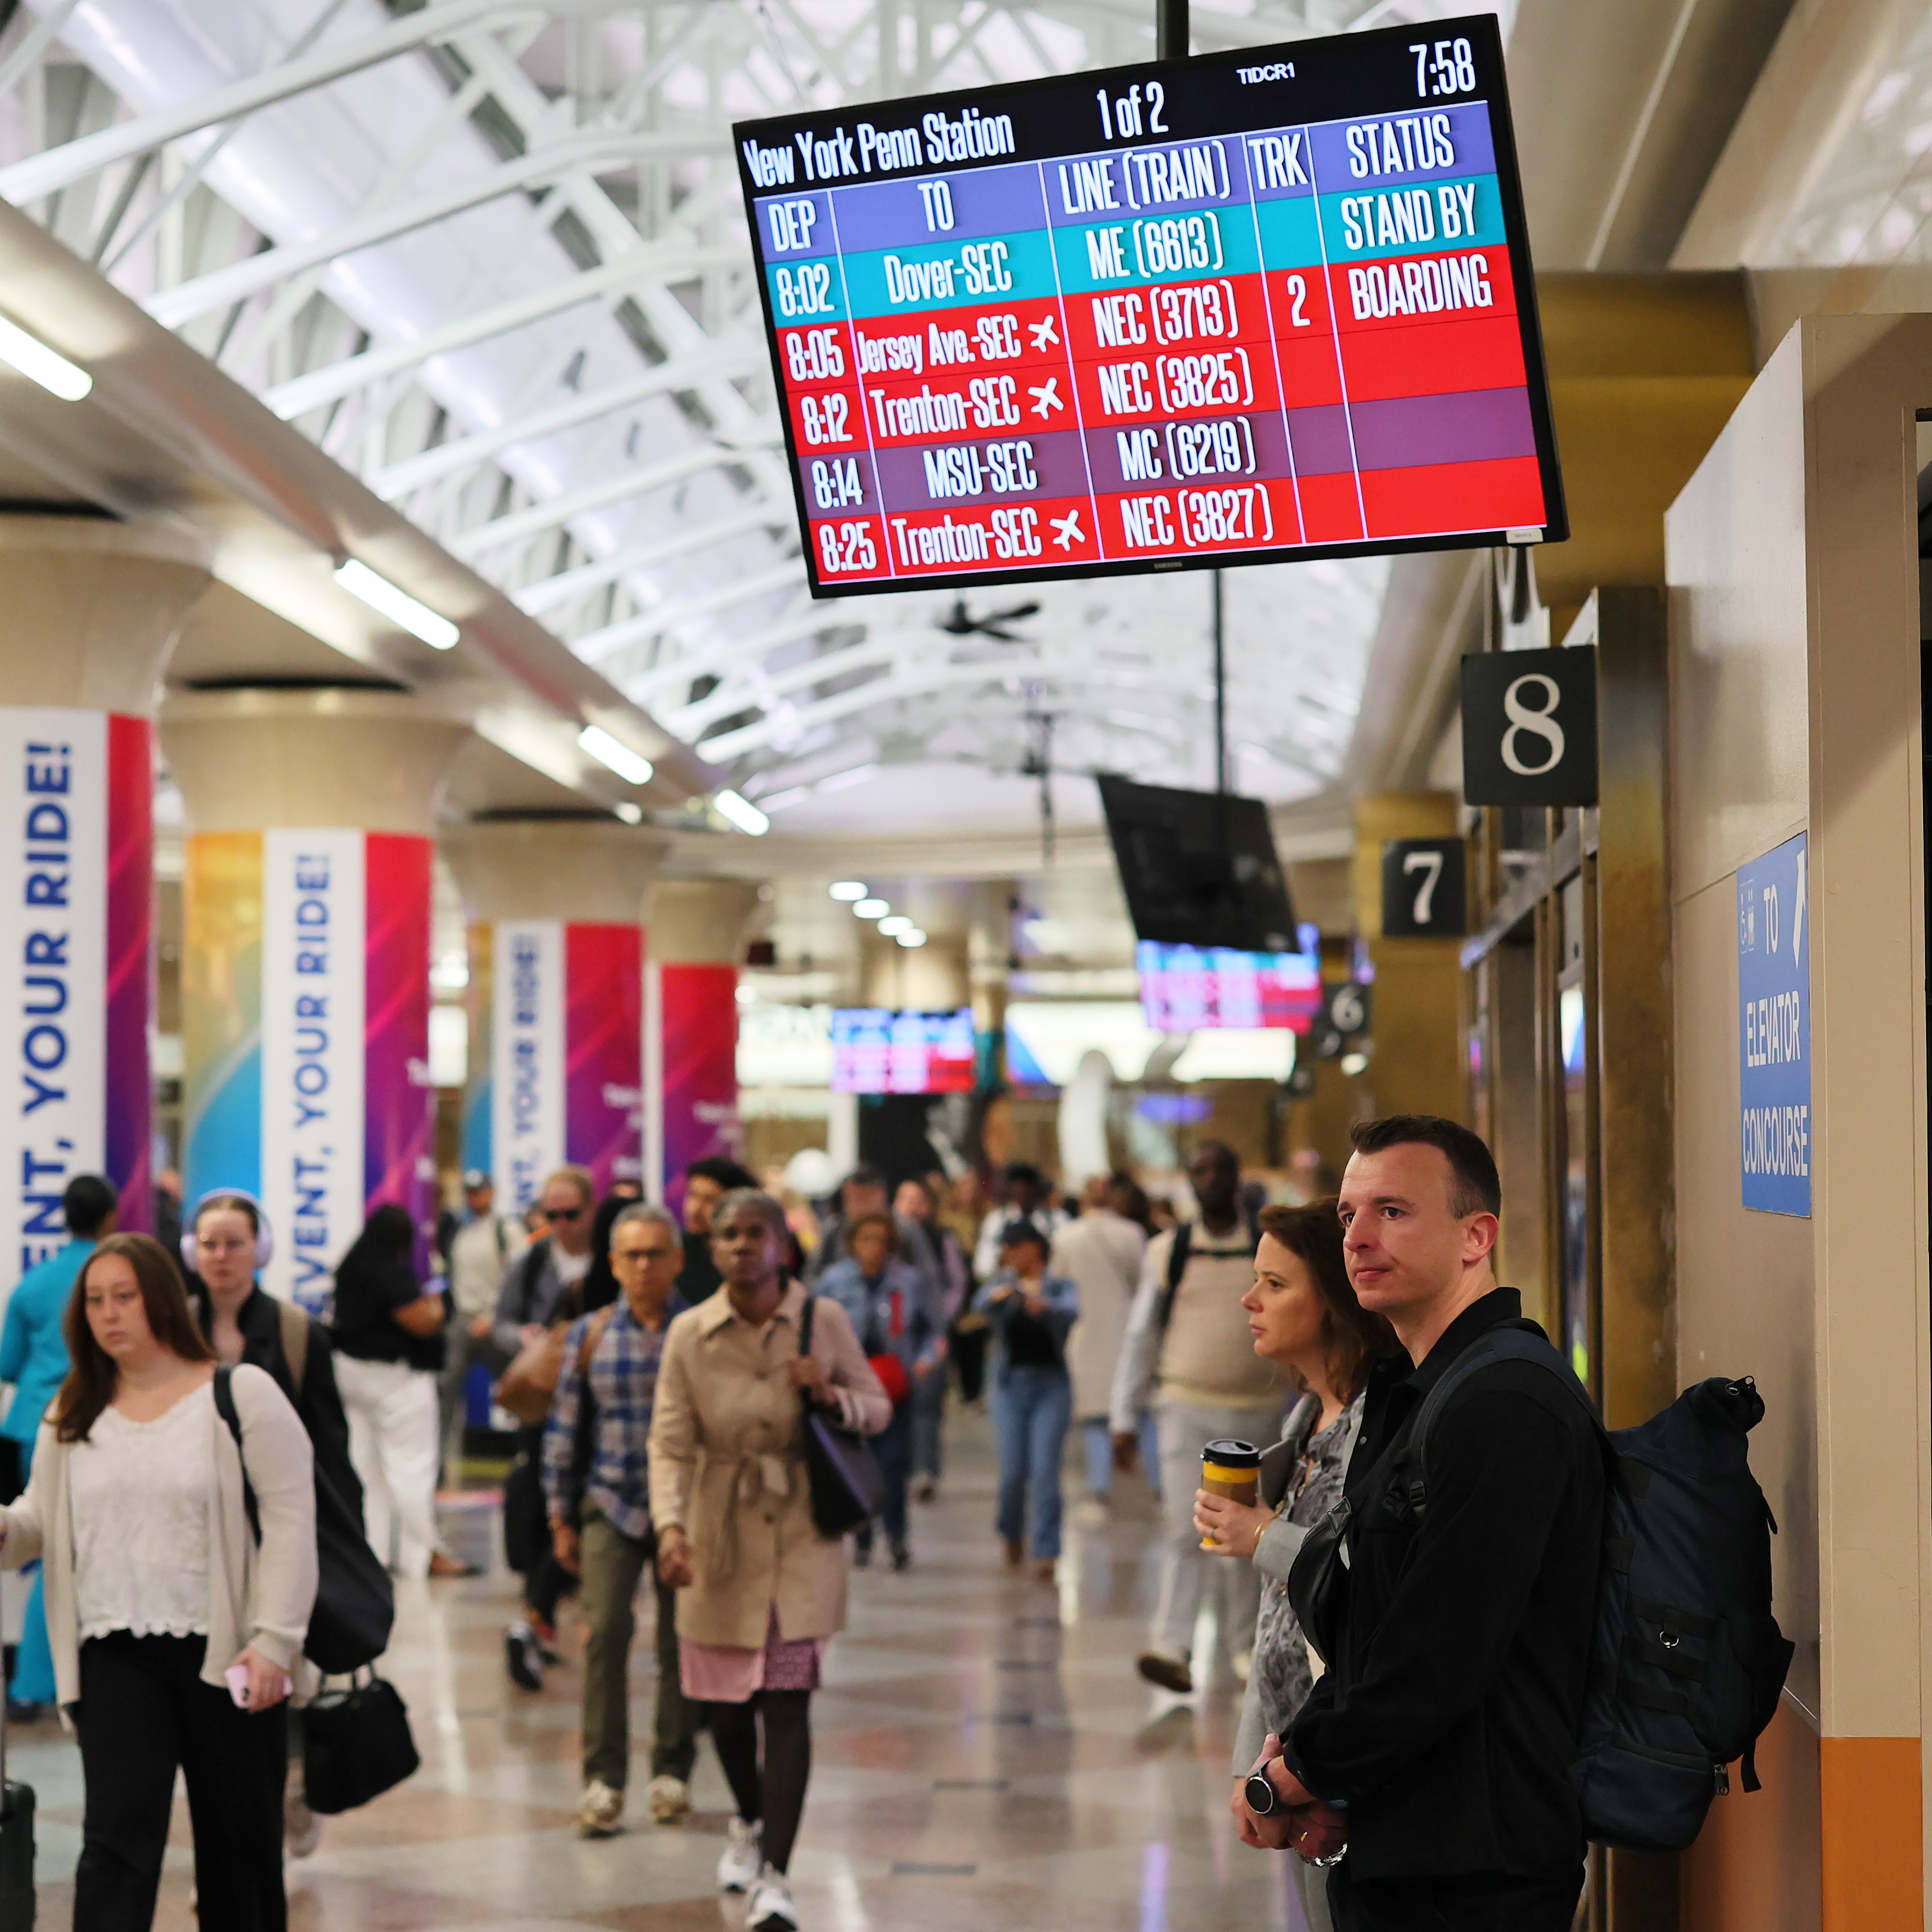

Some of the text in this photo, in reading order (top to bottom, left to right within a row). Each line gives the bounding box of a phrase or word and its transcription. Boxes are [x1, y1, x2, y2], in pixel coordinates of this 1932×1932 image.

[795, 128, 859, 180] York
[858, 124, 923, 172] Penn
[923, 108, 1015, 163] Station
[1097, 89, 1113, 140] 1
[1116, 85, 1143, 138] of
[1146, 82, 1169, 133] 2
[1237, 62, 1295, 84] TIDCR1
[1409, 38, 1475, 97] 7:58
[768, 114, 1454, 252] DEP TO LINE (TRAIN) TRK STATUS
[776, 183, 1475, 316] 8:02 Dover-SEC ME (6613) STAND BY
[786, 254, 1493, 381] 8:05 Jersey Ave.-SEC NEC (3713) 2 BOARDING
[801, 347, 1254, 445] 8:12 Trenton-SEC NEC (3825)
[812, 416, 1256, 509] 8:14 MSU-SEC MC (6219)
[819, 483, 1274, 572] 8:25 Trenton-SEC NEC (3827)
[1501, 673, 1565, 776] 8
[27, 742, 71, 909] RIDE!
[1403, 851, 1444, 924] 7
[1763, 884, 1778, 955] TO
[23, 927, 69, 1115] YOUR
[1331, 986, 1364, 1032] 6
[1746, 991, 1800, 1067] ELEVATOR
[294, 994, 329, 1129] YOUR
[1744, 1105, 1807, 1177] CONCOURSE
